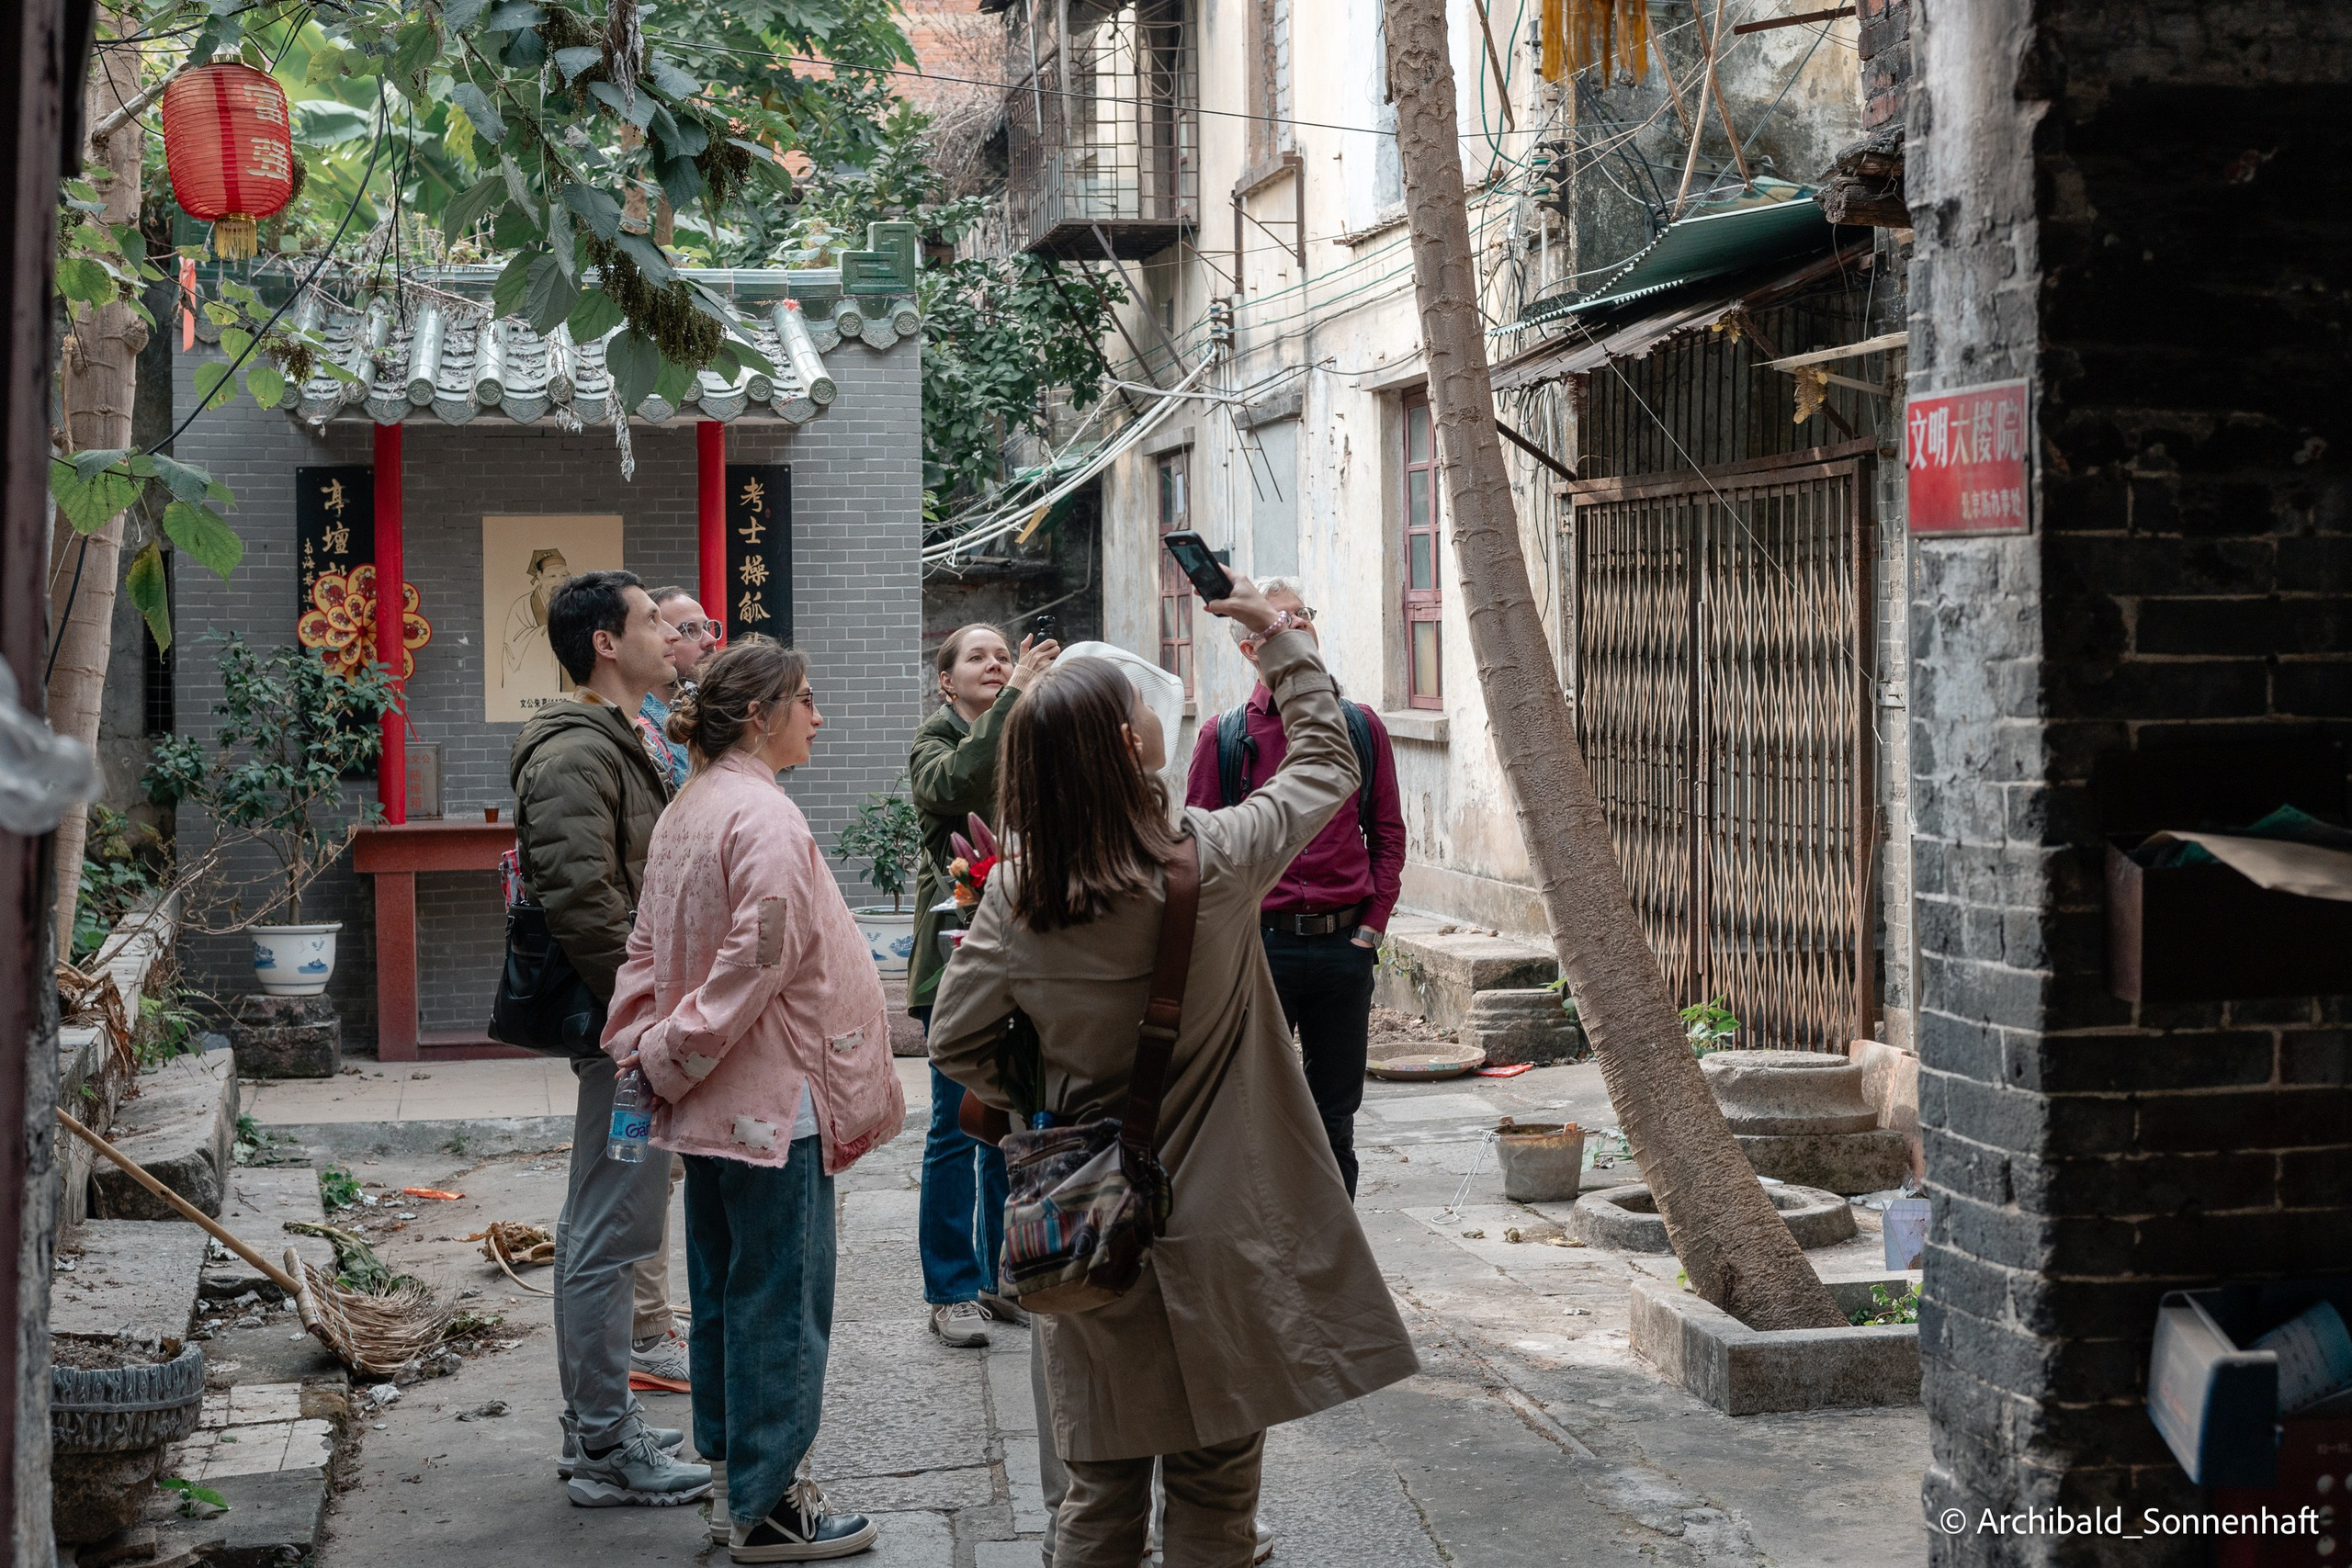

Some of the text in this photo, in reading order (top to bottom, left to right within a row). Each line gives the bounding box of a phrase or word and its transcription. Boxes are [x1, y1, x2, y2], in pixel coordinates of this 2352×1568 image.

[1910, 399, 2020, 470] 文明大楼院
